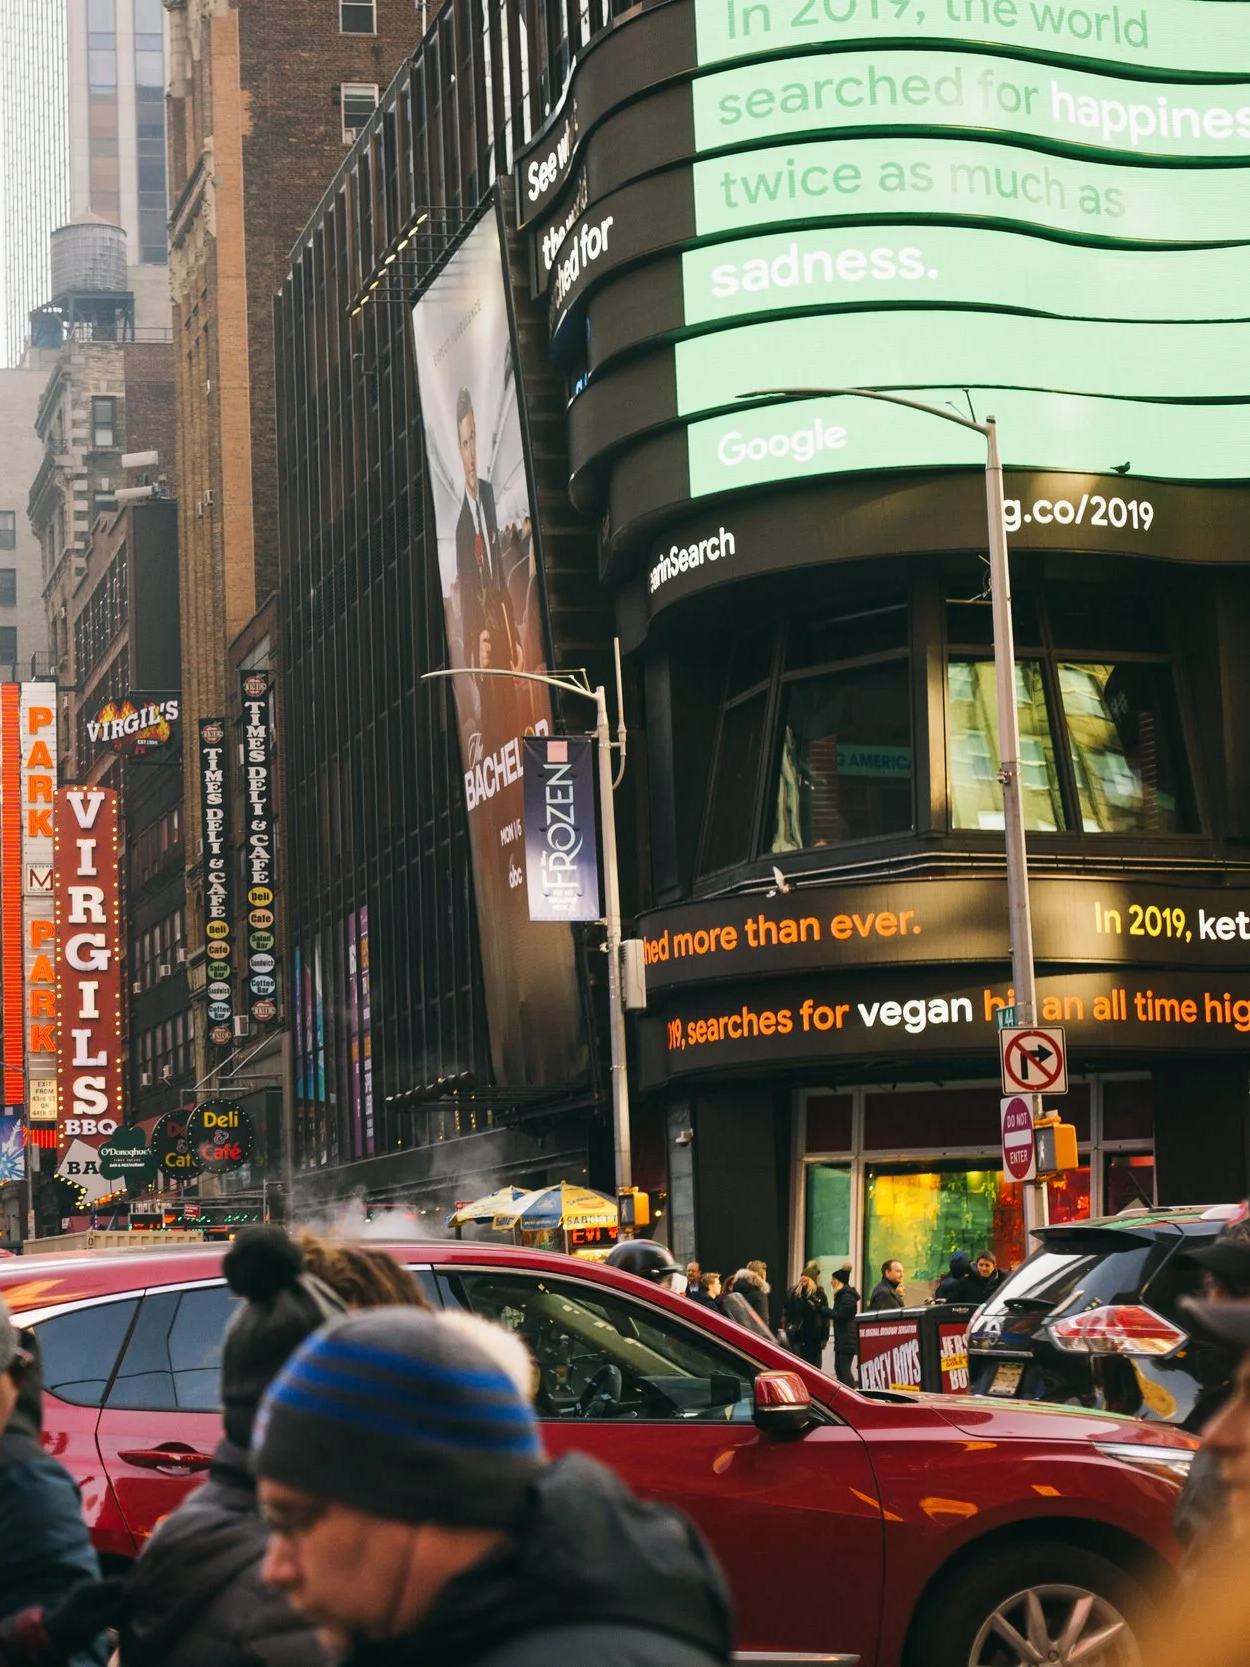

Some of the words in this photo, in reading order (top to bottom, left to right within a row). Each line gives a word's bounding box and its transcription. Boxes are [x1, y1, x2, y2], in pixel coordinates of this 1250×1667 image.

[948, 0, 1018, 28] the
[1034, 1, 1149, 49] world
[718, 66, 963, 125] searched
[977, 69, 1040, 115] for
[527, 151, 557, 201] See
[720, 158, 863, 209] twice
[879, 161, 934, 192] as
[950, 162, 1066, 210] much
[1079, 183, 1126, 218] as
[580, 215, 614, 267] for
[711, 243, 938, 297] sadness.
[717, 418, 847, 466] Google
[1003, 494, 1154, 532] g.co/2019
[86, 700, 179, 742] VIRGIL'S
[244, 701, 267, 763] TIMES
[27, 706, 54, 837] PARK
[203, 748, 223, 805] TIMES
[464, 719, 549, 812] BACHEL
[849, 752, 911, 770] AMERIC
[247, 766, 267, 816] DELI
[205, 808, 224, 854] DELI
[251, 820, 267, 831] &
[542, 763, 583, 890] FROZEN
[209, 859, 224, 869] &
[248, 834, 271, 884] CAFE
[206, 872, 228, 918] CAFE
[251, 892, 270, 901] Deli
[209, 925, 227, 934] Deli
[251, 914, 272, 923] Cafe
[673, 924, 738, 958] more
[744, 914, 821, 947] than
[830, 910, 922, 940] ever.
[1094, 901, 1122, 934] In
[1129, 904, 1192, 943] 2019,
[208, 945, 228, 954] Cafe
[29, 919, 57, 1053] PARK
[1042, 995, 1084, 1021] an
[1093, 988, 1127, 1020] all
[1134, 989, 1197, 1022] time
[687, 1006, 793, 1046] searches
[799, 998, 850, 1032] for
[857, 996, 973, 1034] vegan
[64, 1118, 118, 1136] BBQ
[203, 1110, 239, 1128] Deli
[213, 1129, 230, 1145] &
[1006, 1117, 1016, 1128] DO
[1016, 1112, 1028, 1126] NOT
[100, 1147, 152, 1158] O'Donoghue's
[201, 1141, 242, 1161] Café
[1010, 1150, 1029, 1164] ENTER
[860, 1350, 892, 1390] JERSEY
[892, 1338, 922, 1387] BOYS
